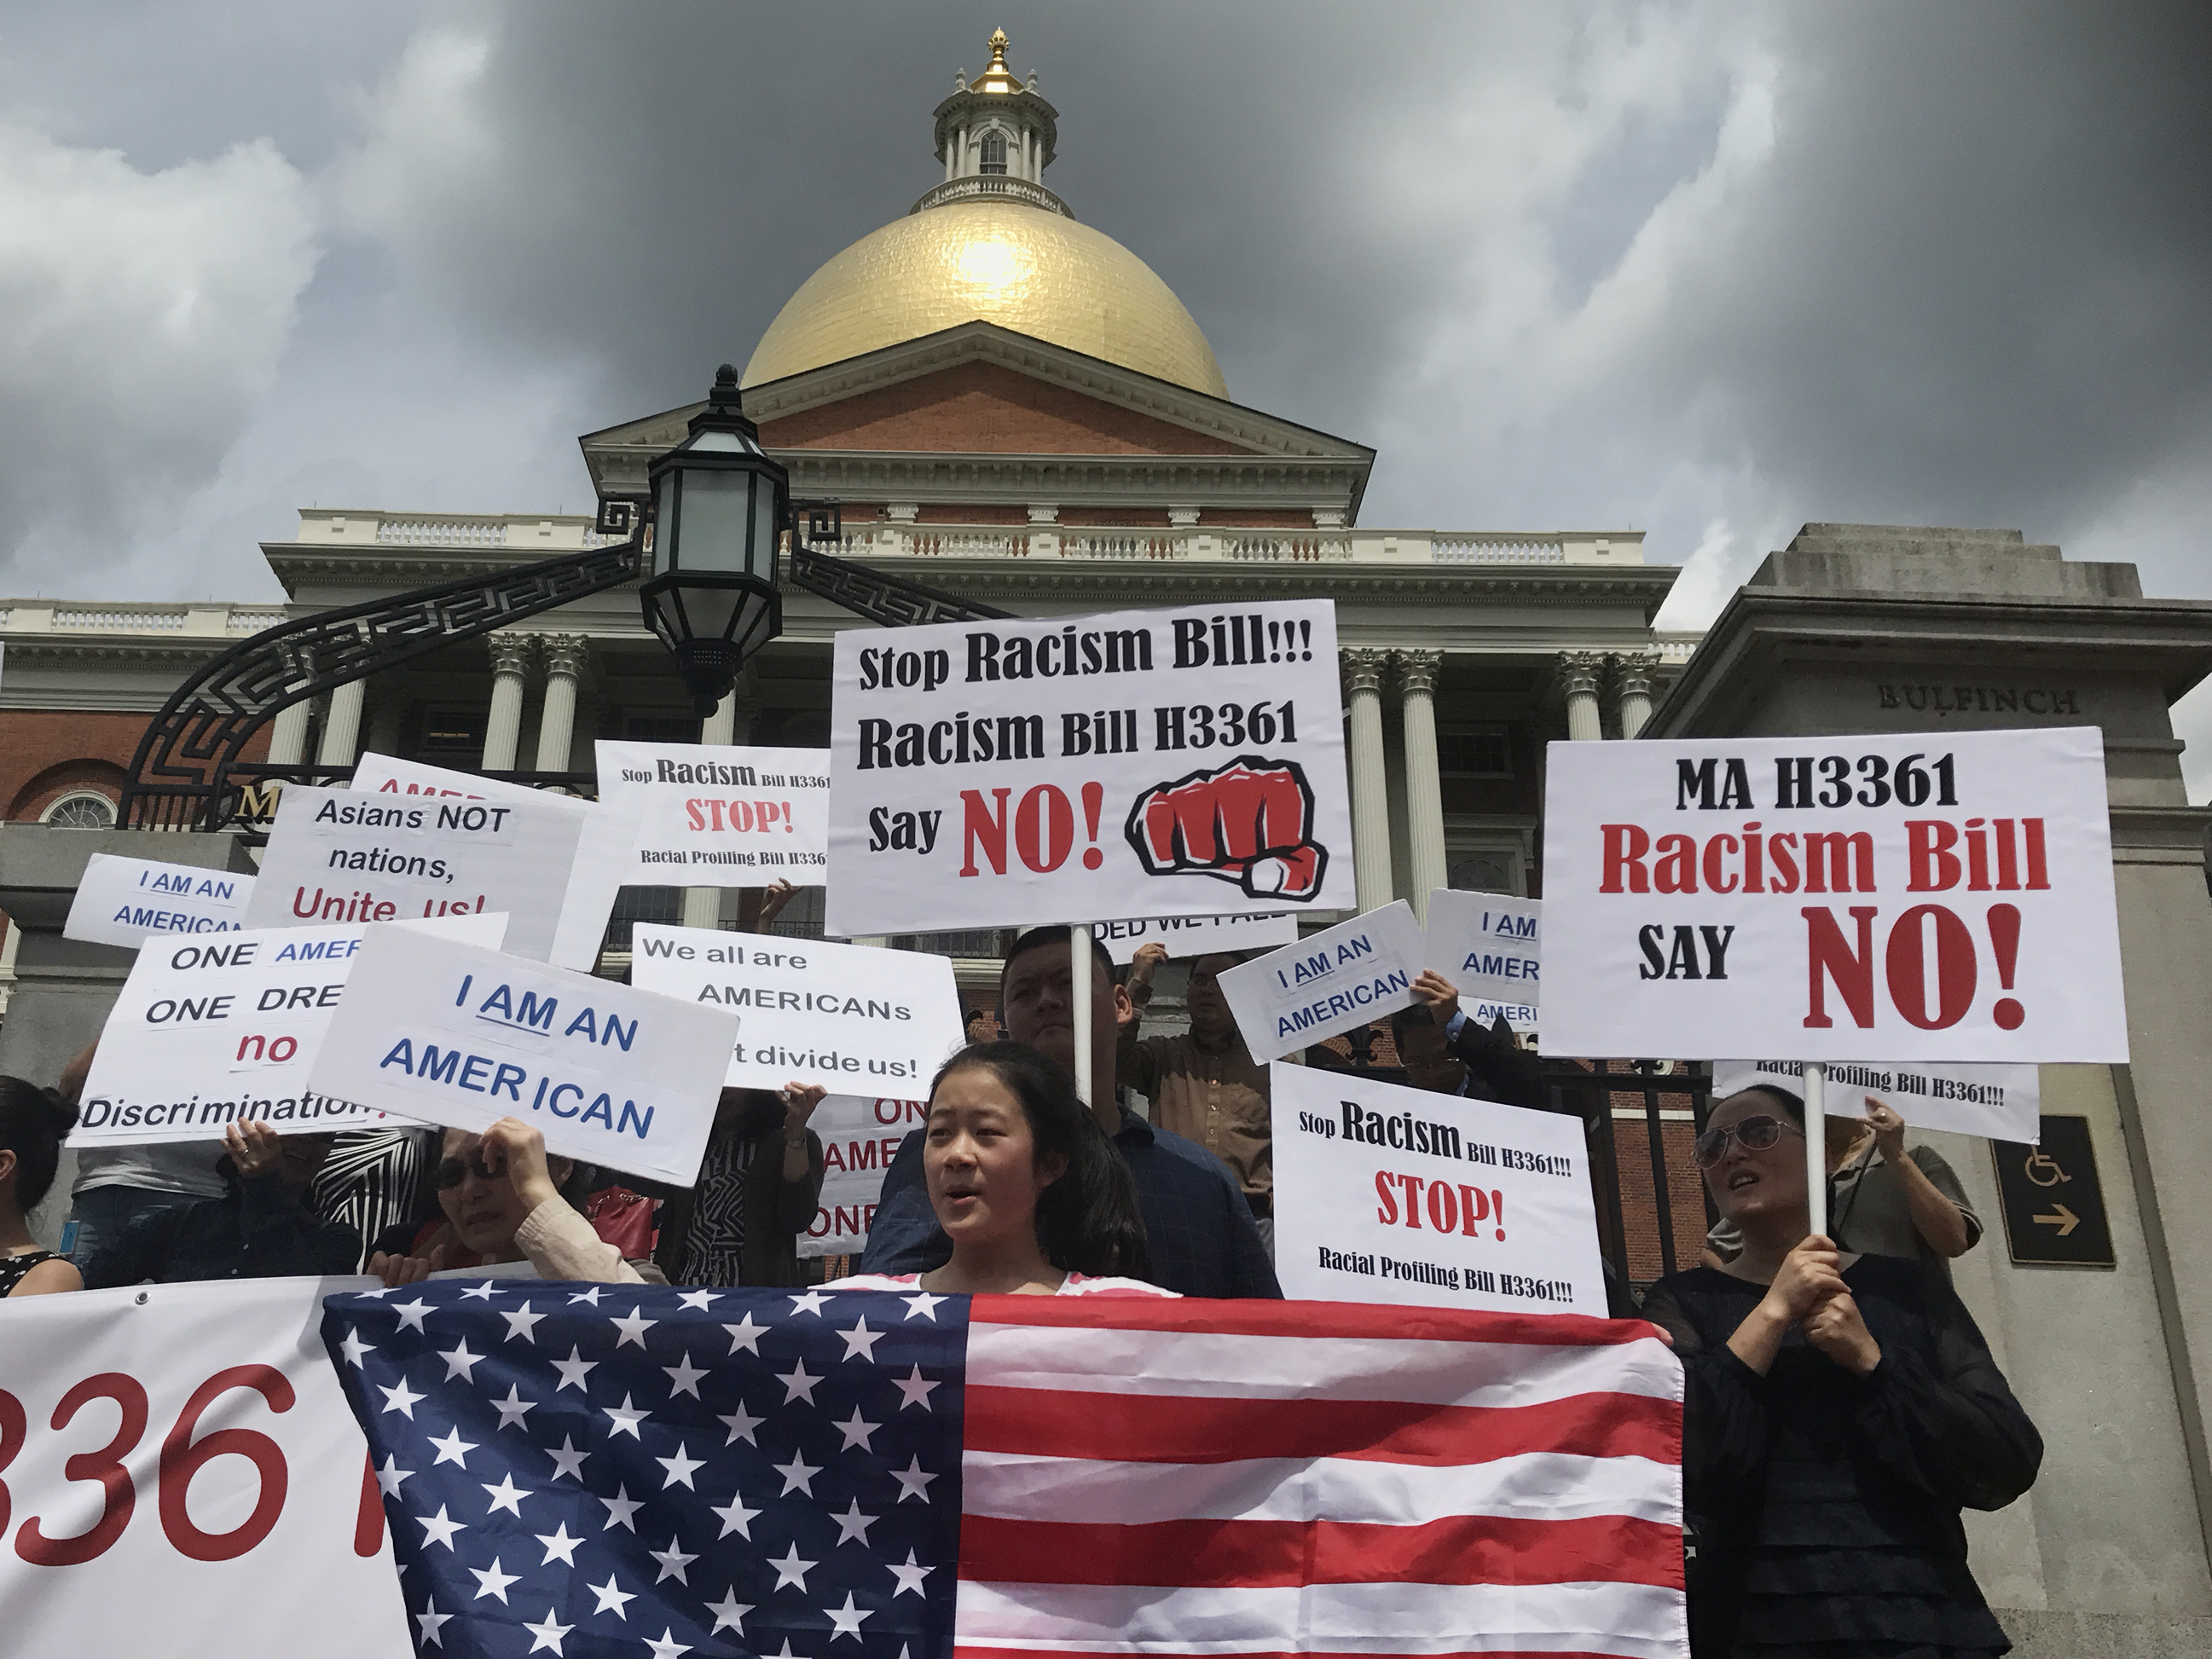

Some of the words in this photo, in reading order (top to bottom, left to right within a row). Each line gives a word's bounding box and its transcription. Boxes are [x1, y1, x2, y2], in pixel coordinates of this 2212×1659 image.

[860, 645, 949, 691] Stop
[964, 625, 1153, 682] Racism
[1172, 614, 1312, 669] Bill!!!
[1879, 685, 2081, 714] BULFINCH
[857, 711, 1044, 770] Racism
[1061, 708, 1138, 757] Bill
[1155, 701, 1297, 751] H3361
[622, 769, 652, 783] Stop
[657, 759, 756, 786] Racism
[761, 774, 785, 787] Bill
[790, 776, 831, 789] H3361
[1676, 758, 1754, 811] MA
[1774, 752, 1959, 810] H3361
[316, 800, 424, 829] Asians
[437, 805, 511, 832] NOT
[686, 798, 793, 833] STOP!
[869, 806, 941, 855] Say
[959, 781, 1103, 877] NO!
[329, 847, 455, 884] nations,
[641, 850, 687, 864] Racial
[692, 851, 756, 866] Profiling
[760, 853, 785, 865] Bill
[789, 853, 828, 865] H336
[1599, 821, 1877, 893] Racism
[1904, 818, 2051, 892] Bill
[140, 870, 149, 887] I
[152, 873, 193, 893] AM
[195, 880, 235, 899] AN
[293, 887, 396, 922] Unite
[1482, 911, 1488, 931] I
[1496, 914, 1536, 937] AM
[171, 943, 258, 969] ONE
[643, 938, 695, 960] We
[707, 946, 743, 964] all
[753, 951, 807, 969] are
[1277, 970, 1288, 988] I
[1295, 952, 1331, 983] AM
[1338, 934, 1373, 966] AN
[1639, 924, 1734, 980] SAY
[1801, 904, 2024, 1031] NO!
[146, 995, 236, 1023] ONE
[456, 974, 472, 1006] I
[480, 984, 558, 1031] AM
[565, 1008, 638, 1051] AN
[698, 984, 911, 1020] AMERICANs
[1279, 969, 1410, 1038] AMERICAN
[236, 1035, 298, 1062] no
[756, 1046, 860, 1072] divide
[869, 1060, 917, 1078] us!
[380, 1038, 654, 1139] AMERICAN
[1896, 1072, 1927, 1095] Bill
[1932, 1078, 2005, 1107] H3361!!!
[1300, 1111, 1335, 1139] Stop
[1341, 1101, 1462, 1159] Racism
[1467, 1142, 1497, 1165] Bill
[1501, 1148, 1572, 1177] H3361!!!
[1375, 1171, 1506, 1242] STOP!
[1318, 1246, 1375, 1276] Racial
[1381, 1256, 1459, 1291] Profiling
[1464, 1269, 1495, 1293] Bill
[1501, 1275, 1573, 1304] H3361!!!
